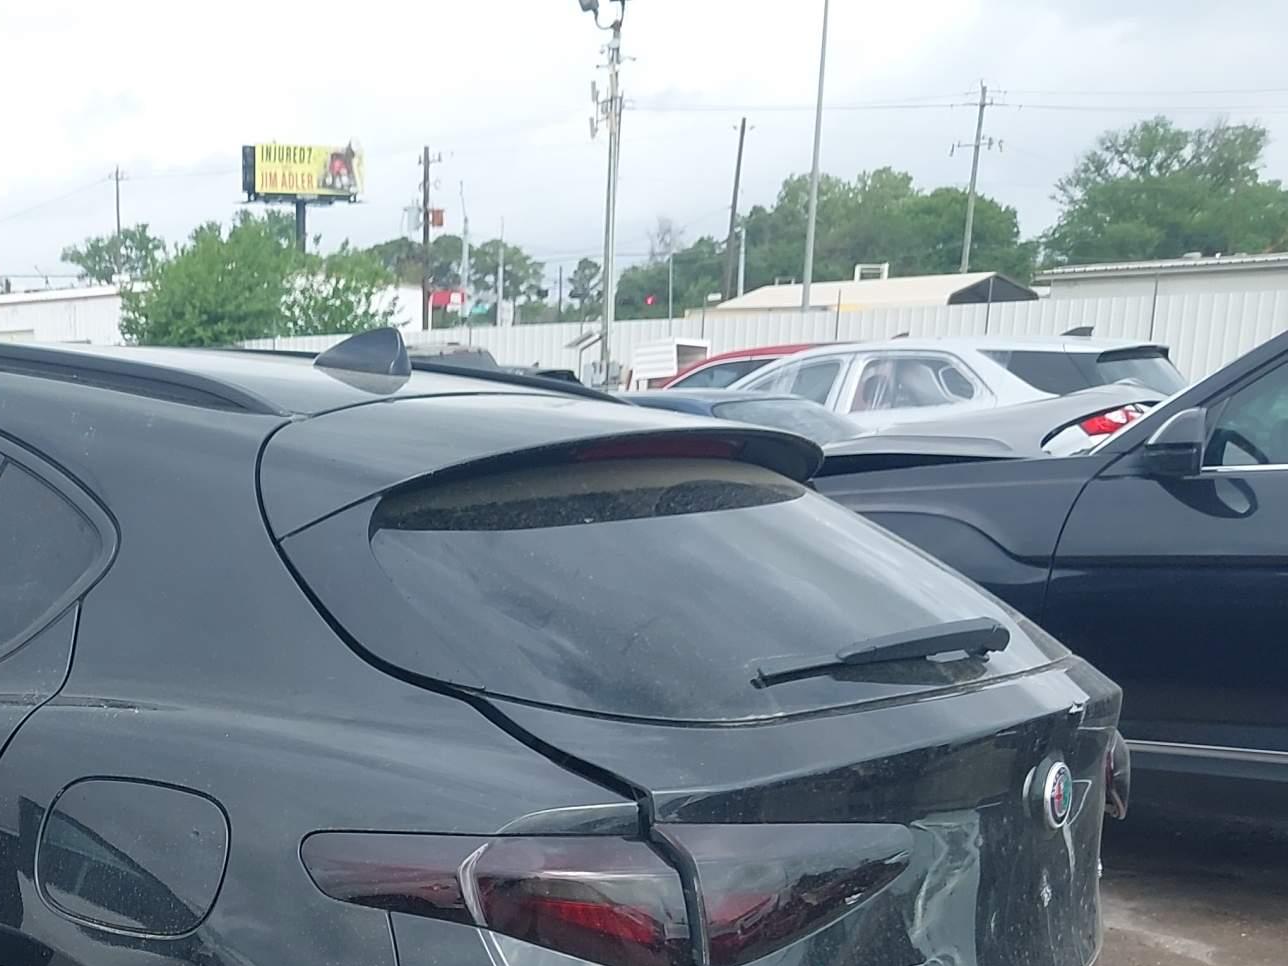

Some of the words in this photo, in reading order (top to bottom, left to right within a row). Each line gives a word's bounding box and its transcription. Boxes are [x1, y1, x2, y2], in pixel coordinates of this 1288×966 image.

[261, 145, 313, 164] INJURED?
[260, 171, 279, 190] JIM
[280, 171, 315, 191] ADLER
